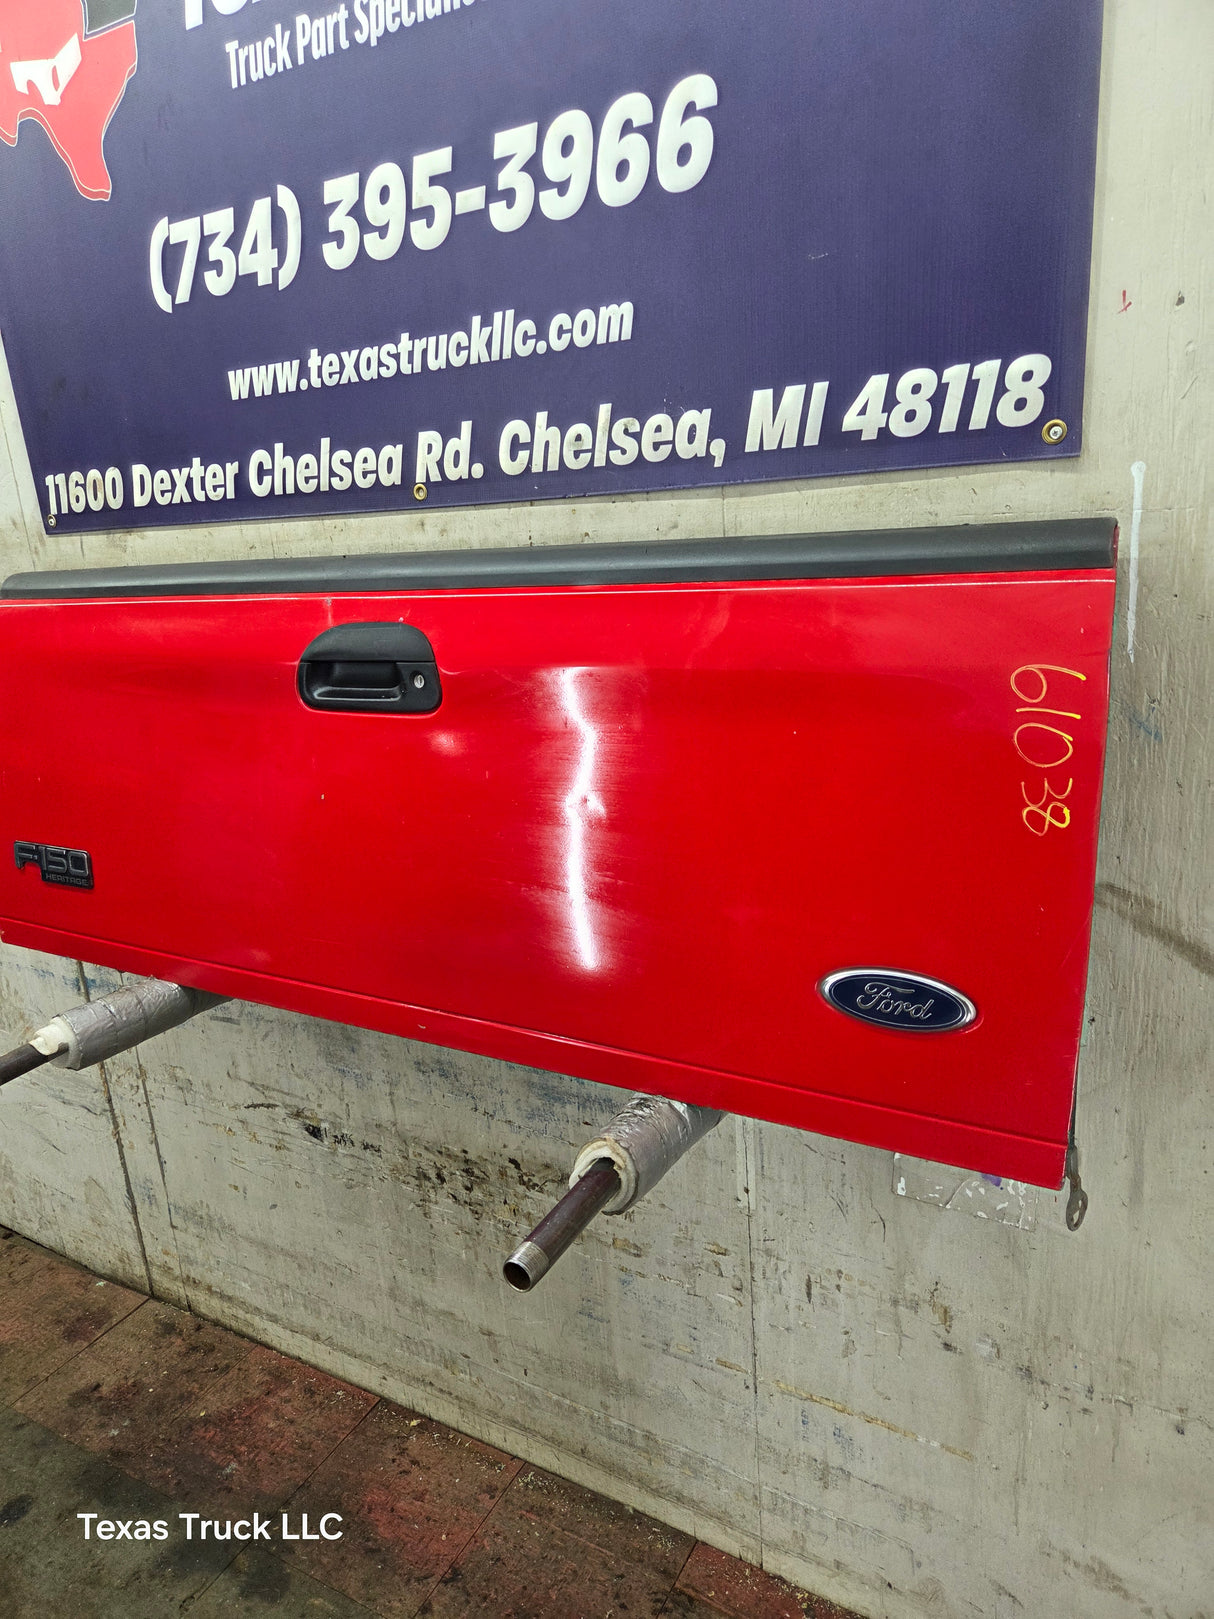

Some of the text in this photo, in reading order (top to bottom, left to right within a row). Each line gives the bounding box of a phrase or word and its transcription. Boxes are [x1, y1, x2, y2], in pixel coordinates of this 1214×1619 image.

[224, 23, 293, 89] Truck
[295, 3, 350, 65] Part
[149, 73, 718, 314] (734) 395-3966
[227, 301, 634, 401] www.texastruckllc.com
[45, 353, 1052, 515] 11600 Dexter Chelsea Rd. Chelsea, MI 48118
[14, 841, 90, 876] F-150
[45, 873, 89, 887] HERITAGE
[856, 981, 935, 1020] Ford
